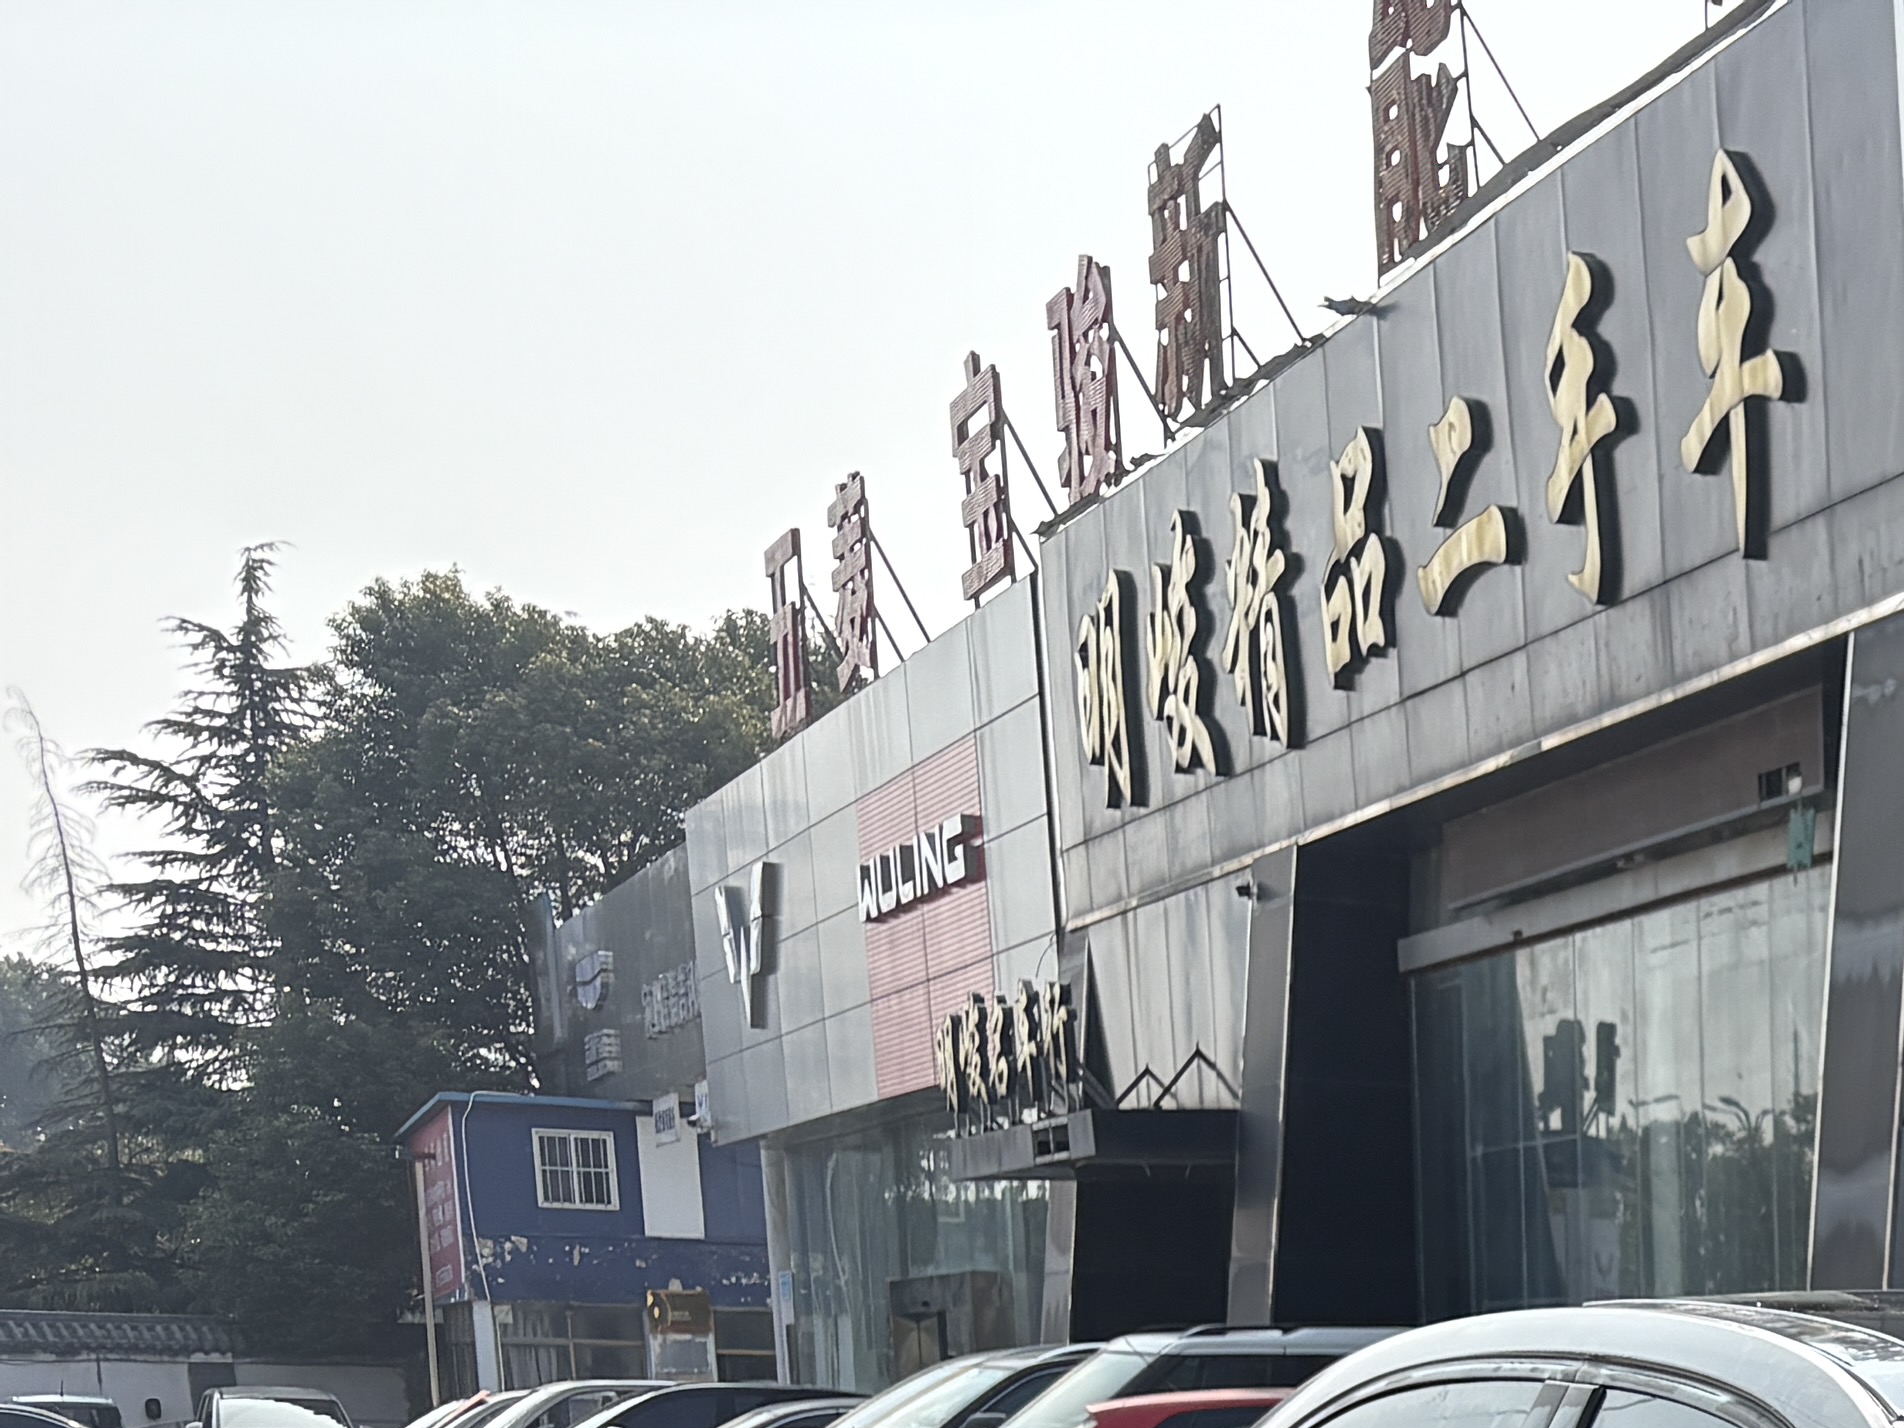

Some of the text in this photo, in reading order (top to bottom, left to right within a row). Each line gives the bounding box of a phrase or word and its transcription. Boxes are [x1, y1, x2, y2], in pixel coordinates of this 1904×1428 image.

[1075, 148, 1784, 808] 明峻精品二手车
[857, 813, 966, 922] WULING
